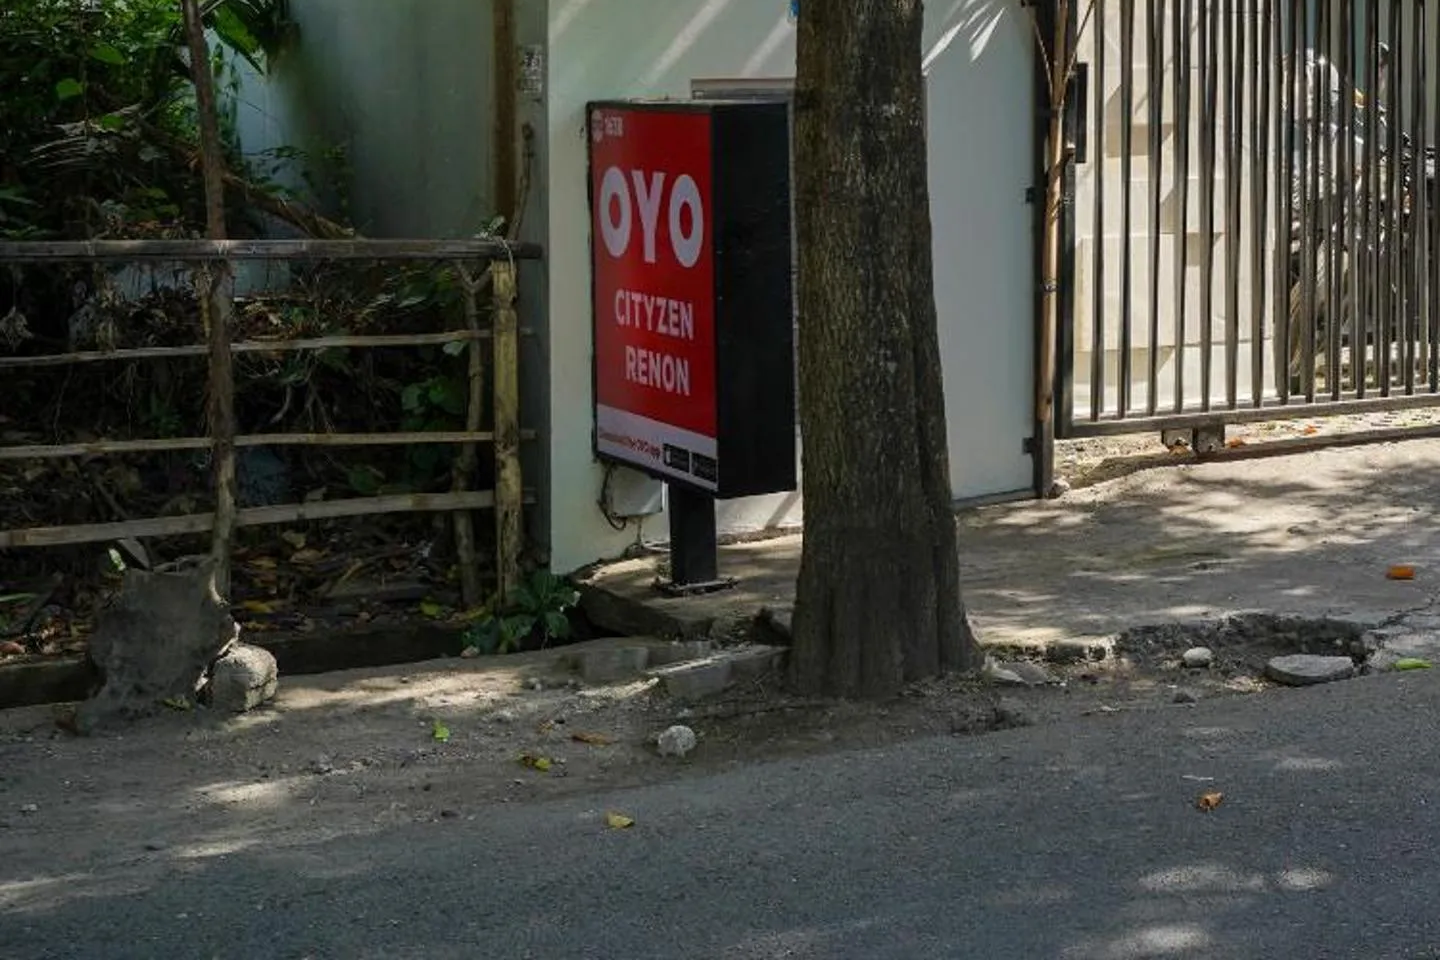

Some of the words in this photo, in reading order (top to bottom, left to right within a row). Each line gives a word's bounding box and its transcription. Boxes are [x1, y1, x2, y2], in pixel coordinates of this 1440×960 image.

[600, 165, 704, 269] OYO
[615, 289, 694, 340] CITYZEN
[625, 345, 691, 397] RENON
